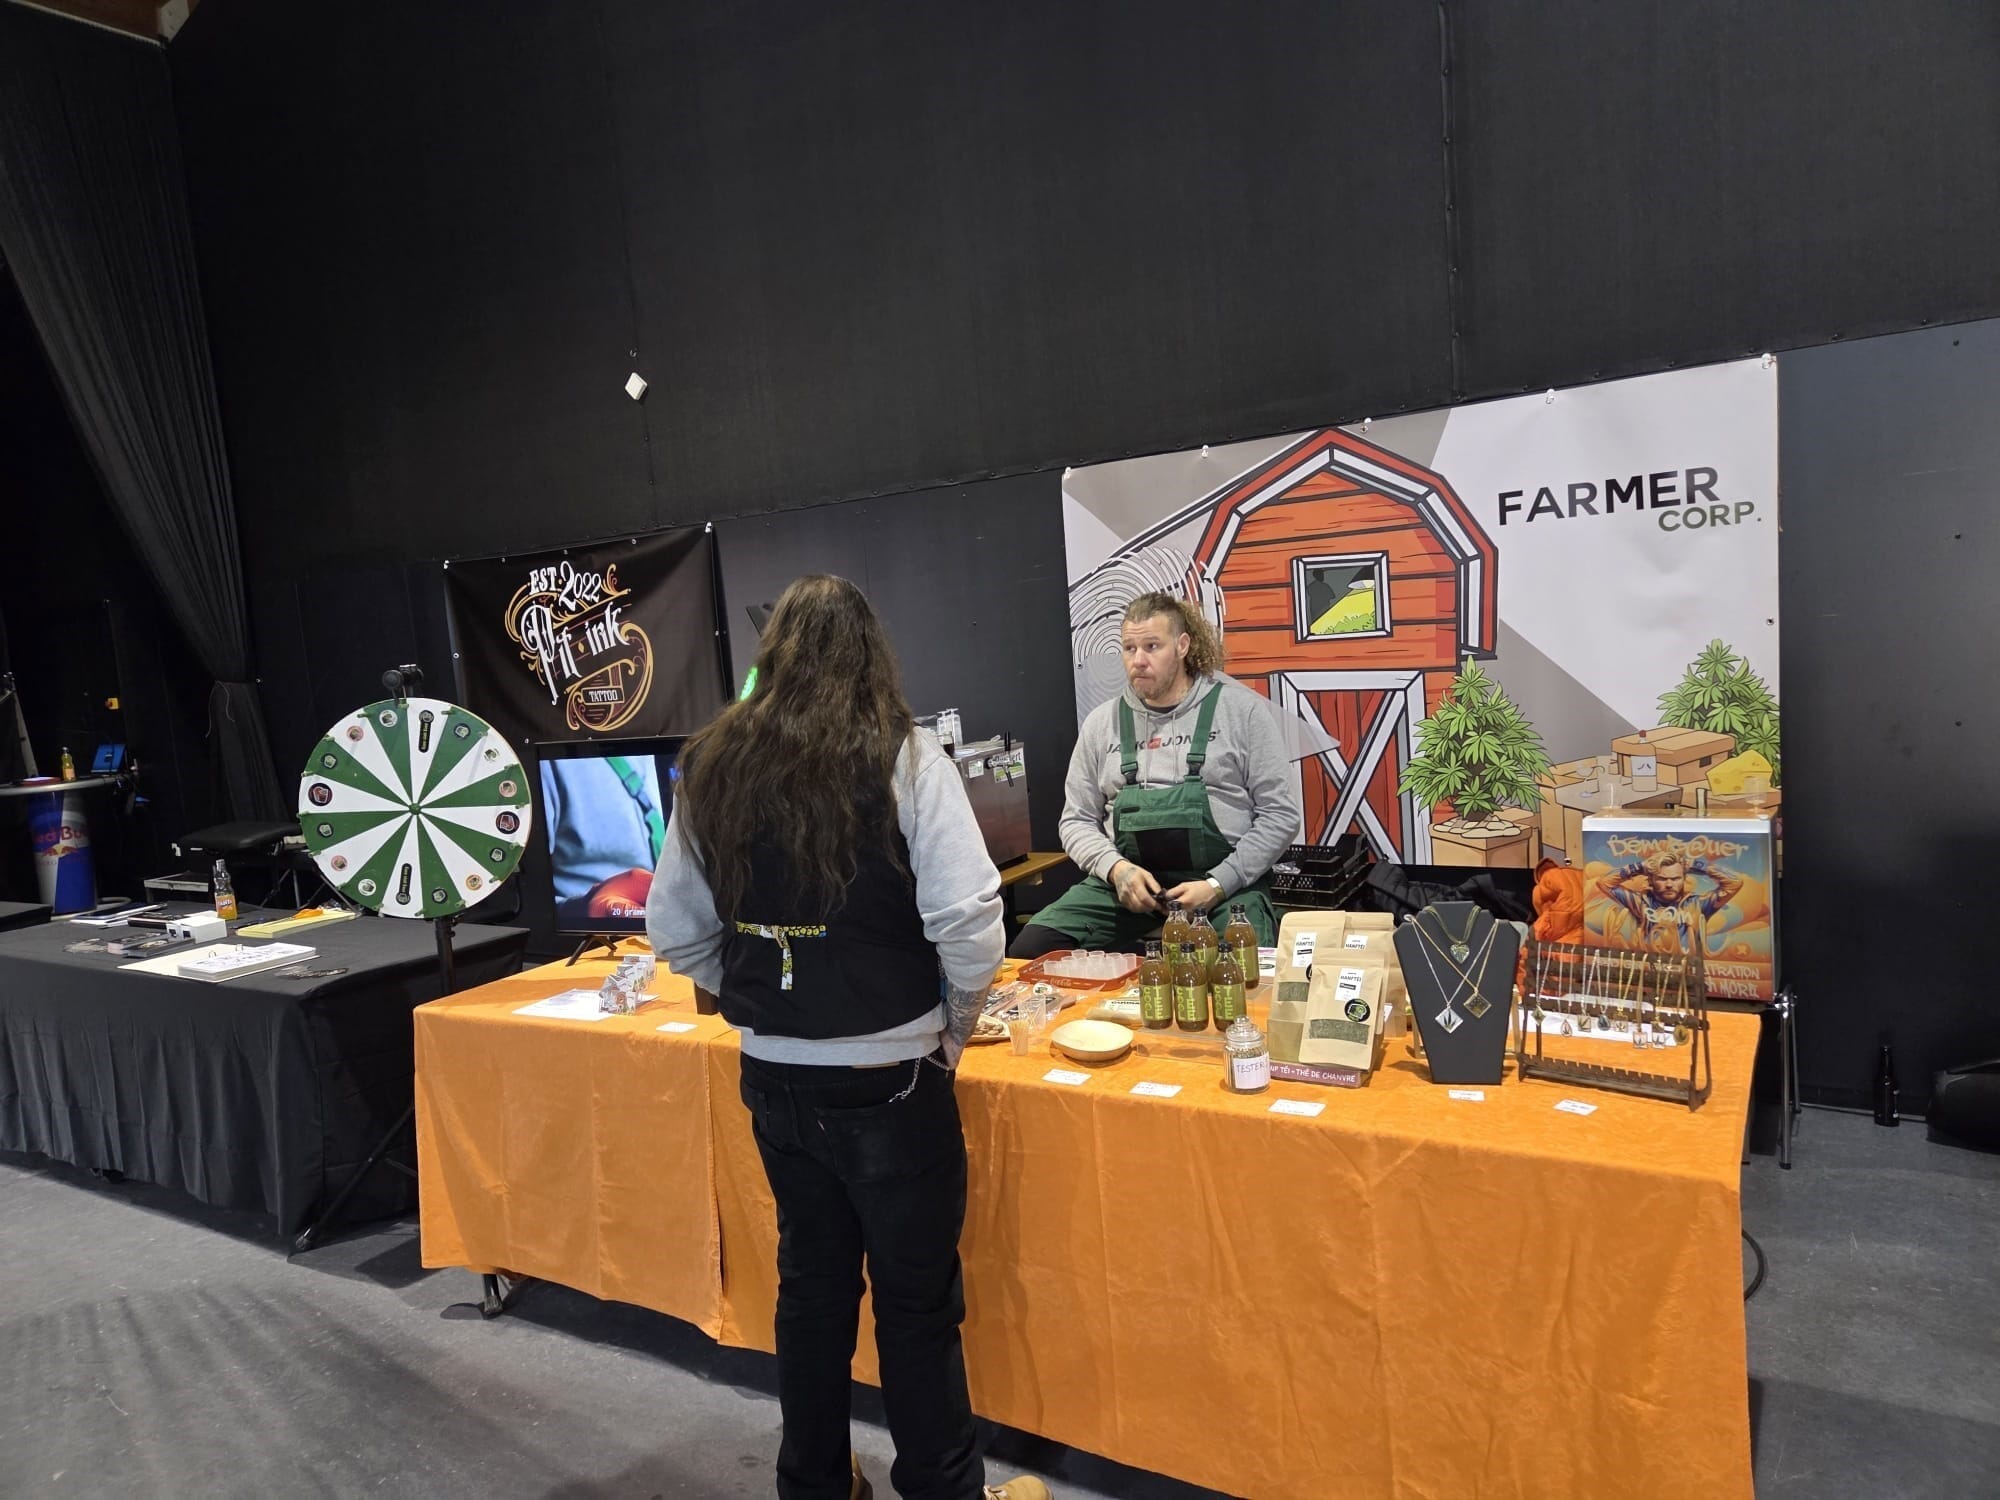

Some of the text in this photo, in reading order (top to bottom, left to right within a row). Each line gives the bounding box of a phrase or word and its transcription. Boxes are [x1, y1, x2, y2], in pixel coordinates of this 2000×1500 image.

[1498, 466, 1720, 526] FARMER
[1659, 501, 1762, 532] CORP.
[588, 689, 618, 702] TATTOO
[1106, 731, 1217, 753] JAK JONS
[612, 907, 621, 916] 20
[1236, 1061, 1265, 1074] TESTER
[1296, 1068, 1310, 1077] THÉ
[1311, 1070, 1320, 1079] DE
[1322, 1072, 1356, 1083] CHANVRE
